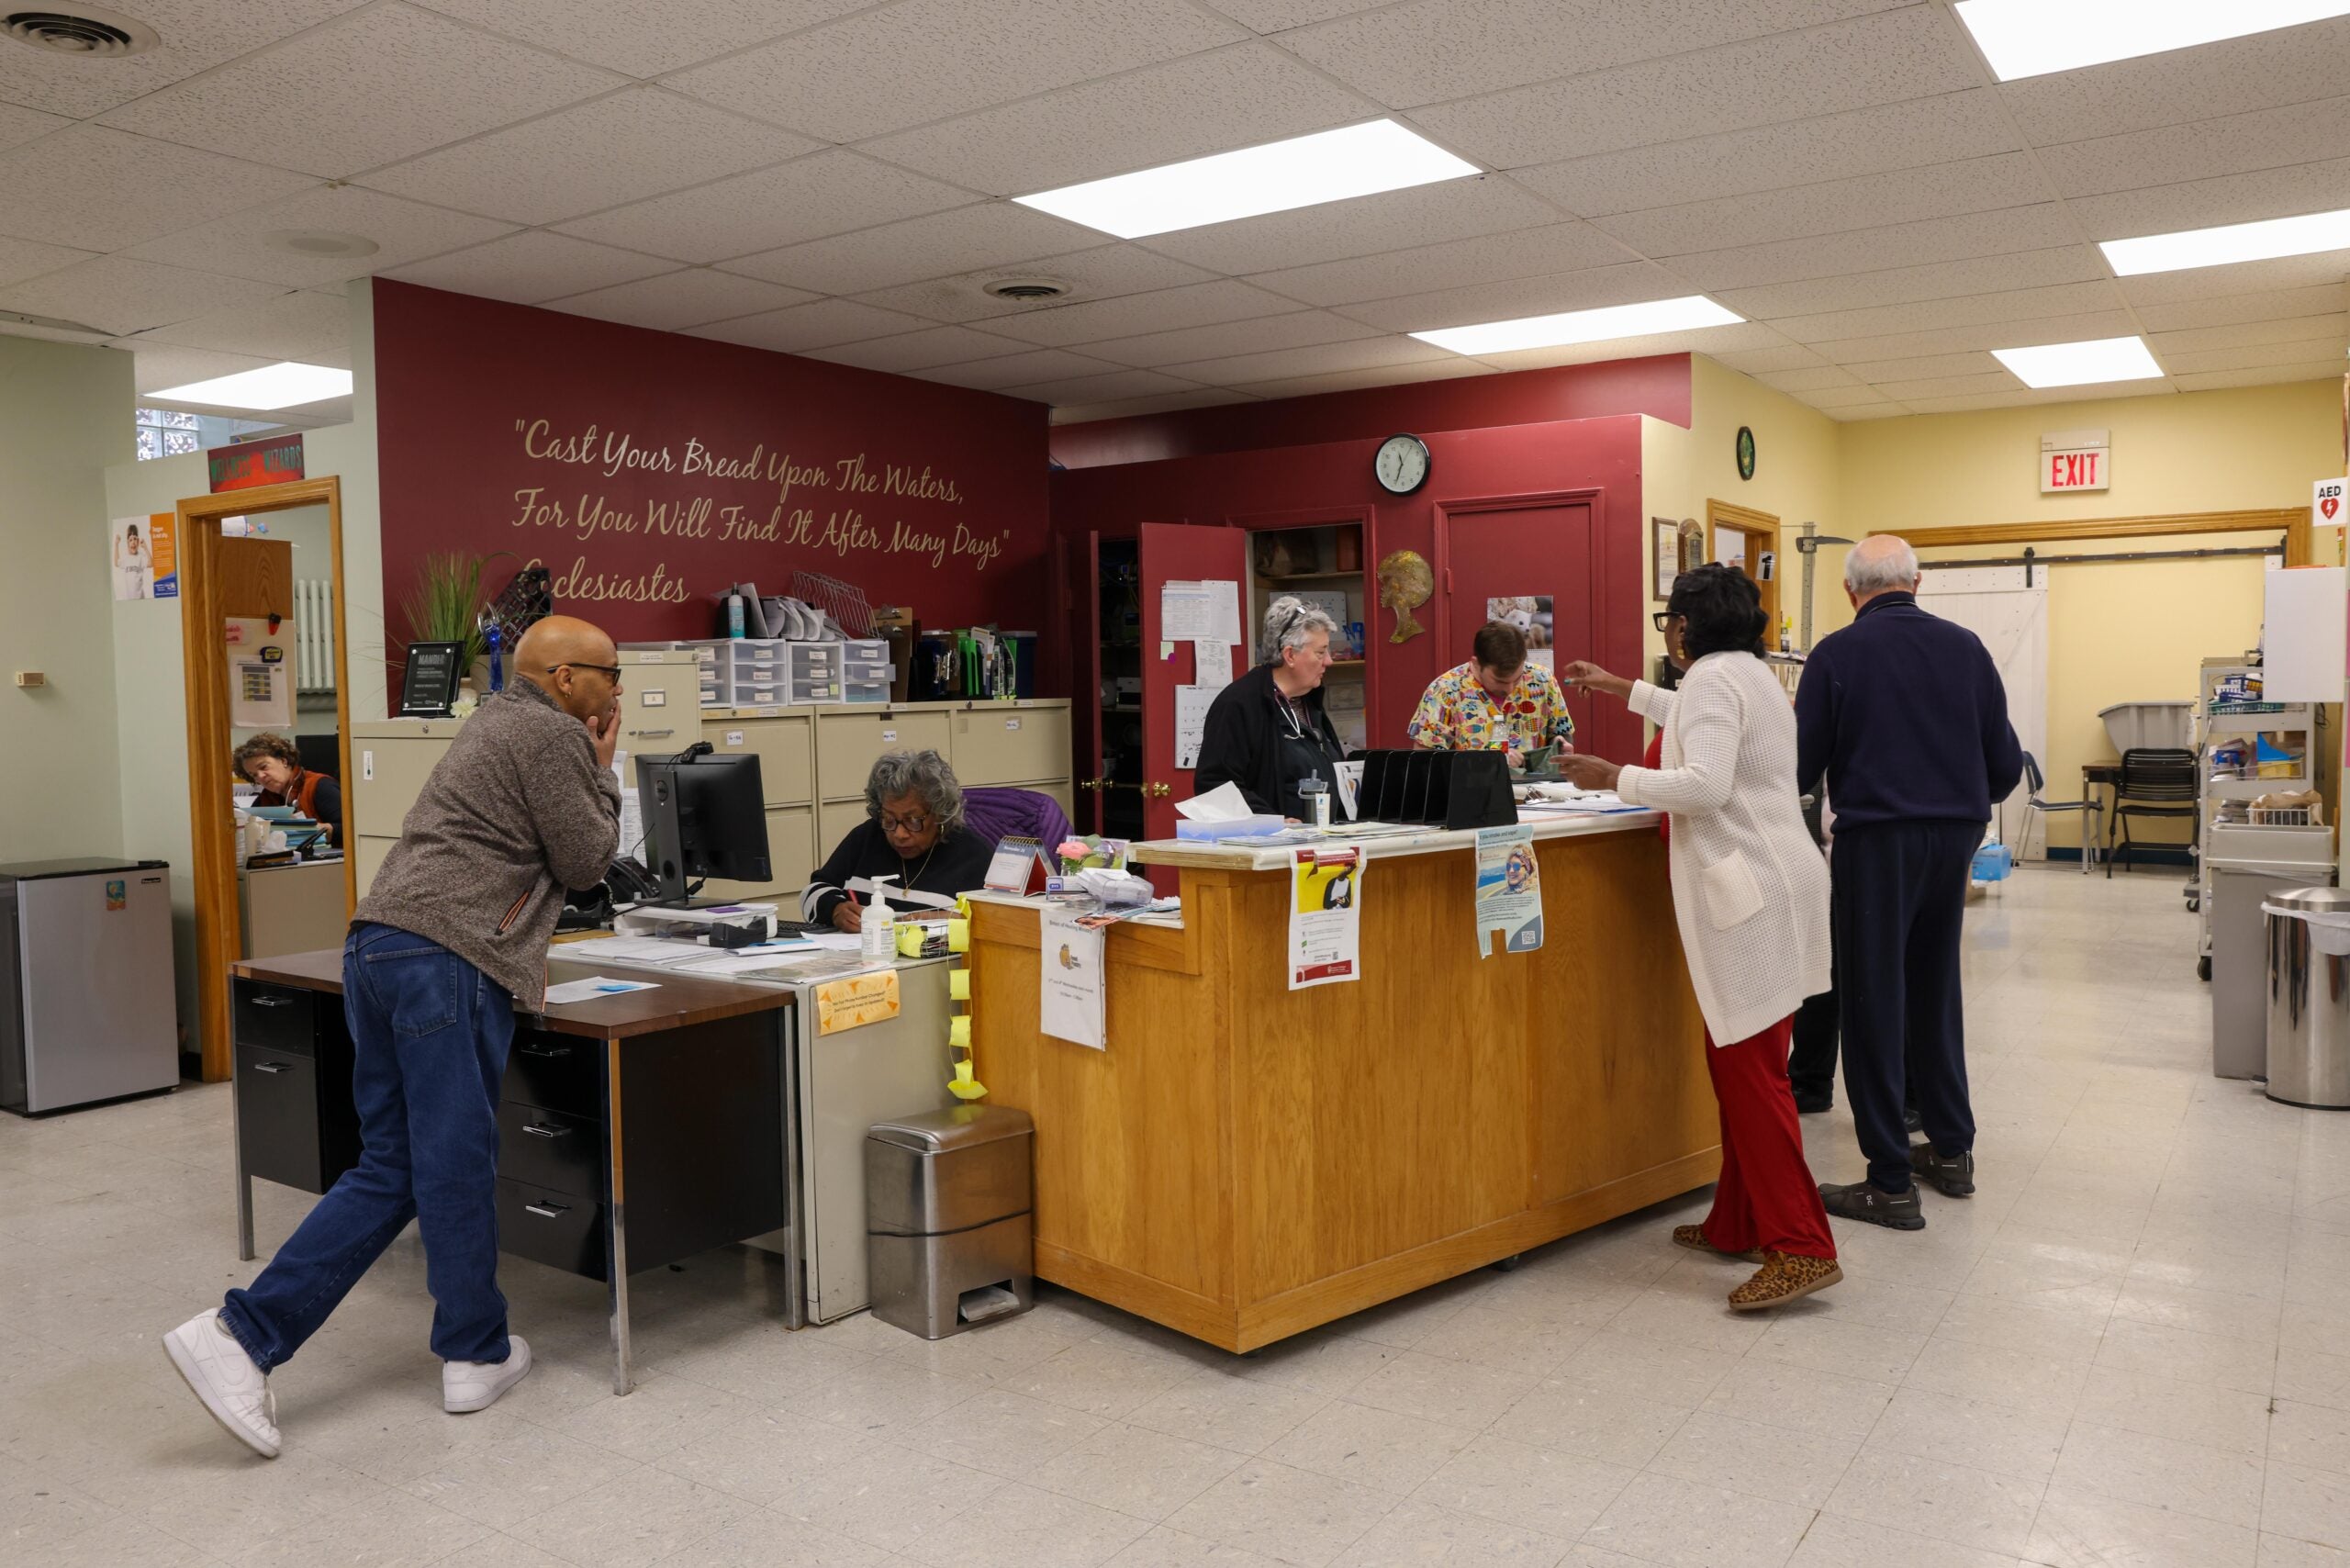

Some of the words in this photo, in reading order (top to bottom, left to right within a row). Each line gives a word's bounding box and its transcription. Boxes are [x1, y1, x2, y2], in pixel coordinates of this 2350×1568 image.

[263, 444, 301, 473] WIZARDS
[516, 420, 597, 464] "Cast
[603, 431, 677, 476] Your
[683, 437, 762, 480] Bread
[767, 453, 830, 504] Upon
[836, 454, 879, 491] The
[884, 464, 963, 504] Waters,
[2052, 453, 2099, 487] EXIT
[2318, 486, 2341, 498] AED
[512, 487, 569, 528] For
[576, 494, 638, 540] You
[644, 498, 711, 538] Will
[718, 505, 780, 541] Find
[784, 510, 813, 545] It
[813, 510, 881, 556] After
[884, 521, 946, 568] Many
[953, 522, 1010, 570] Days"
[1762, 555, 1773, 579] 1
